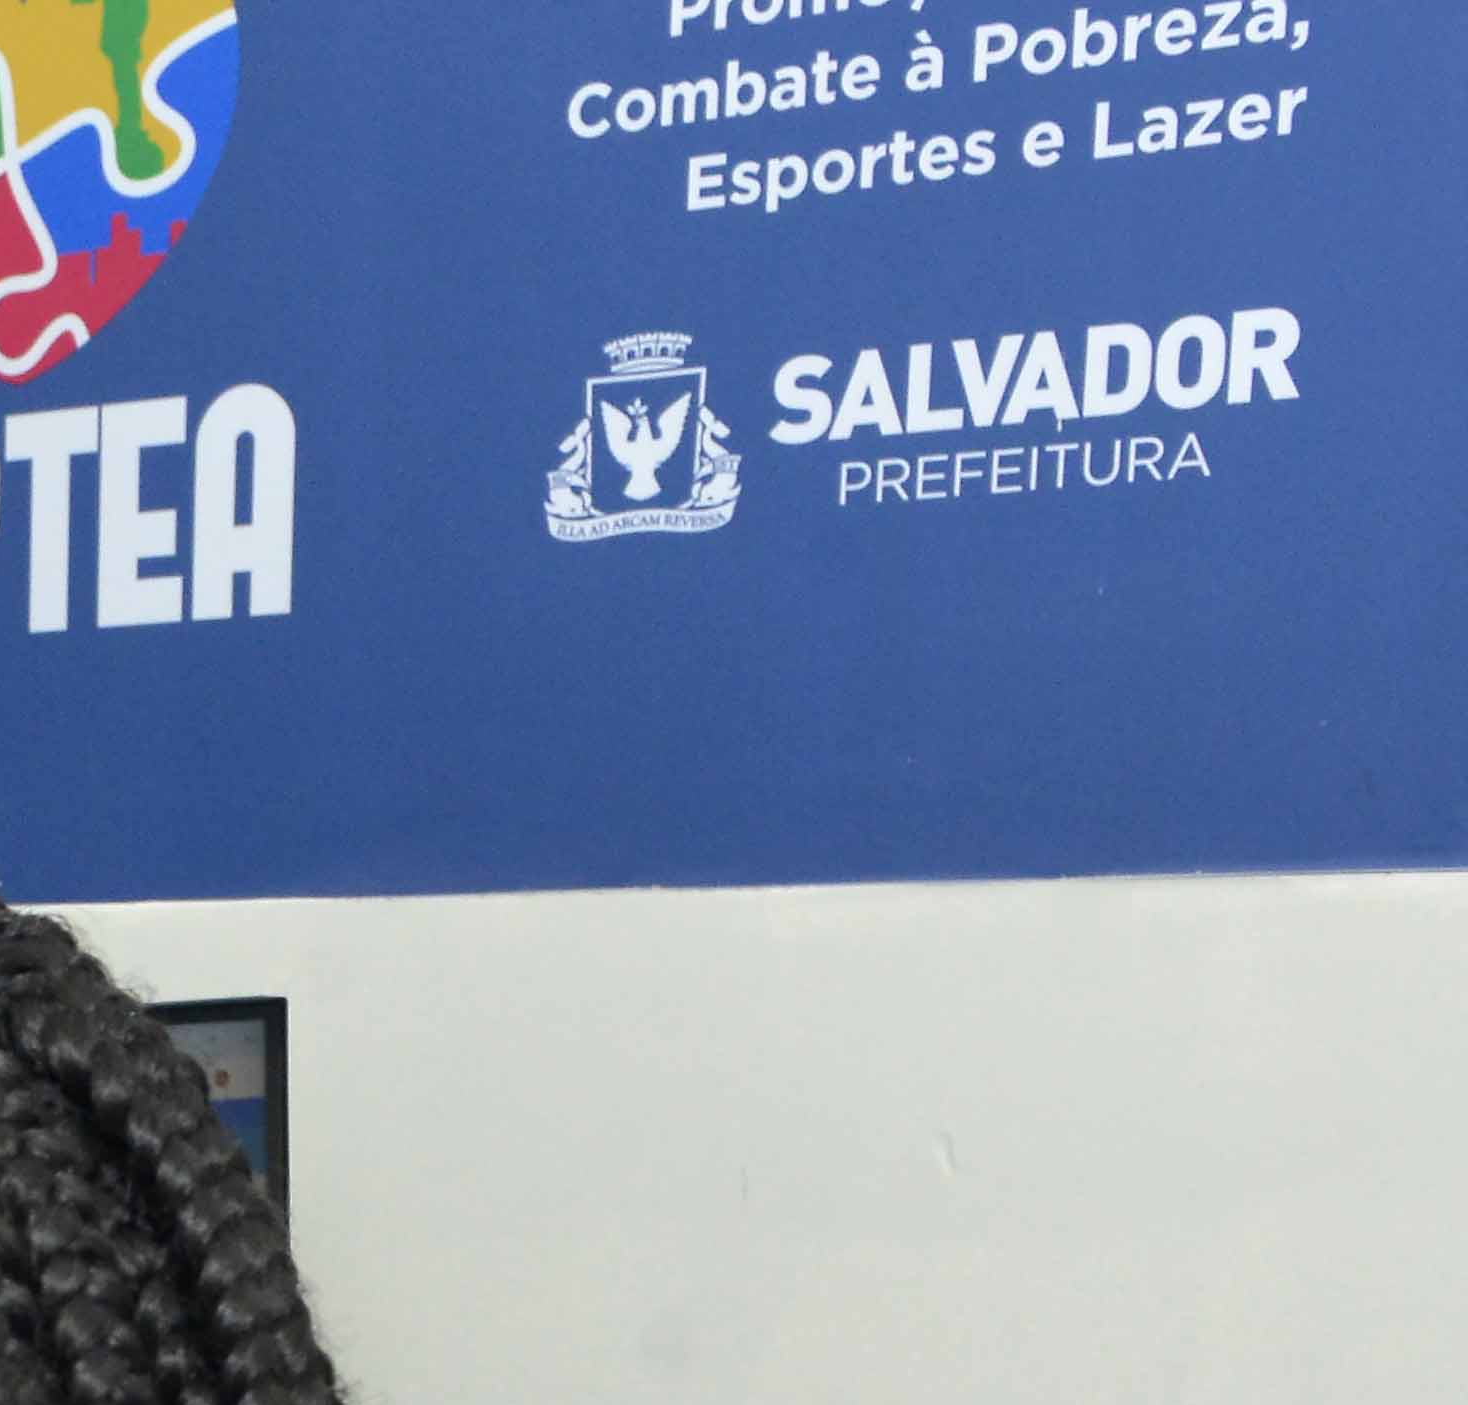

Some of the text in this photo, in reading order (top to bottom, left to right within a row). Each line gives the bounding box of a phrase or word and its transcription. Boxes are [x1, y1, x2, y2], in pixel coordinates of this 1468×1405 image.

[567, 48, 881, 139] Combate
[905, 29, 944, 92] à
[973, 0, 1310, 83] Pobreza,
[687, 85, 1308, 213] Esportes e Lazer
[769, 307, 1301, 445] SALVADOR
[839, 432, 1211, 506] PREFEITURA
